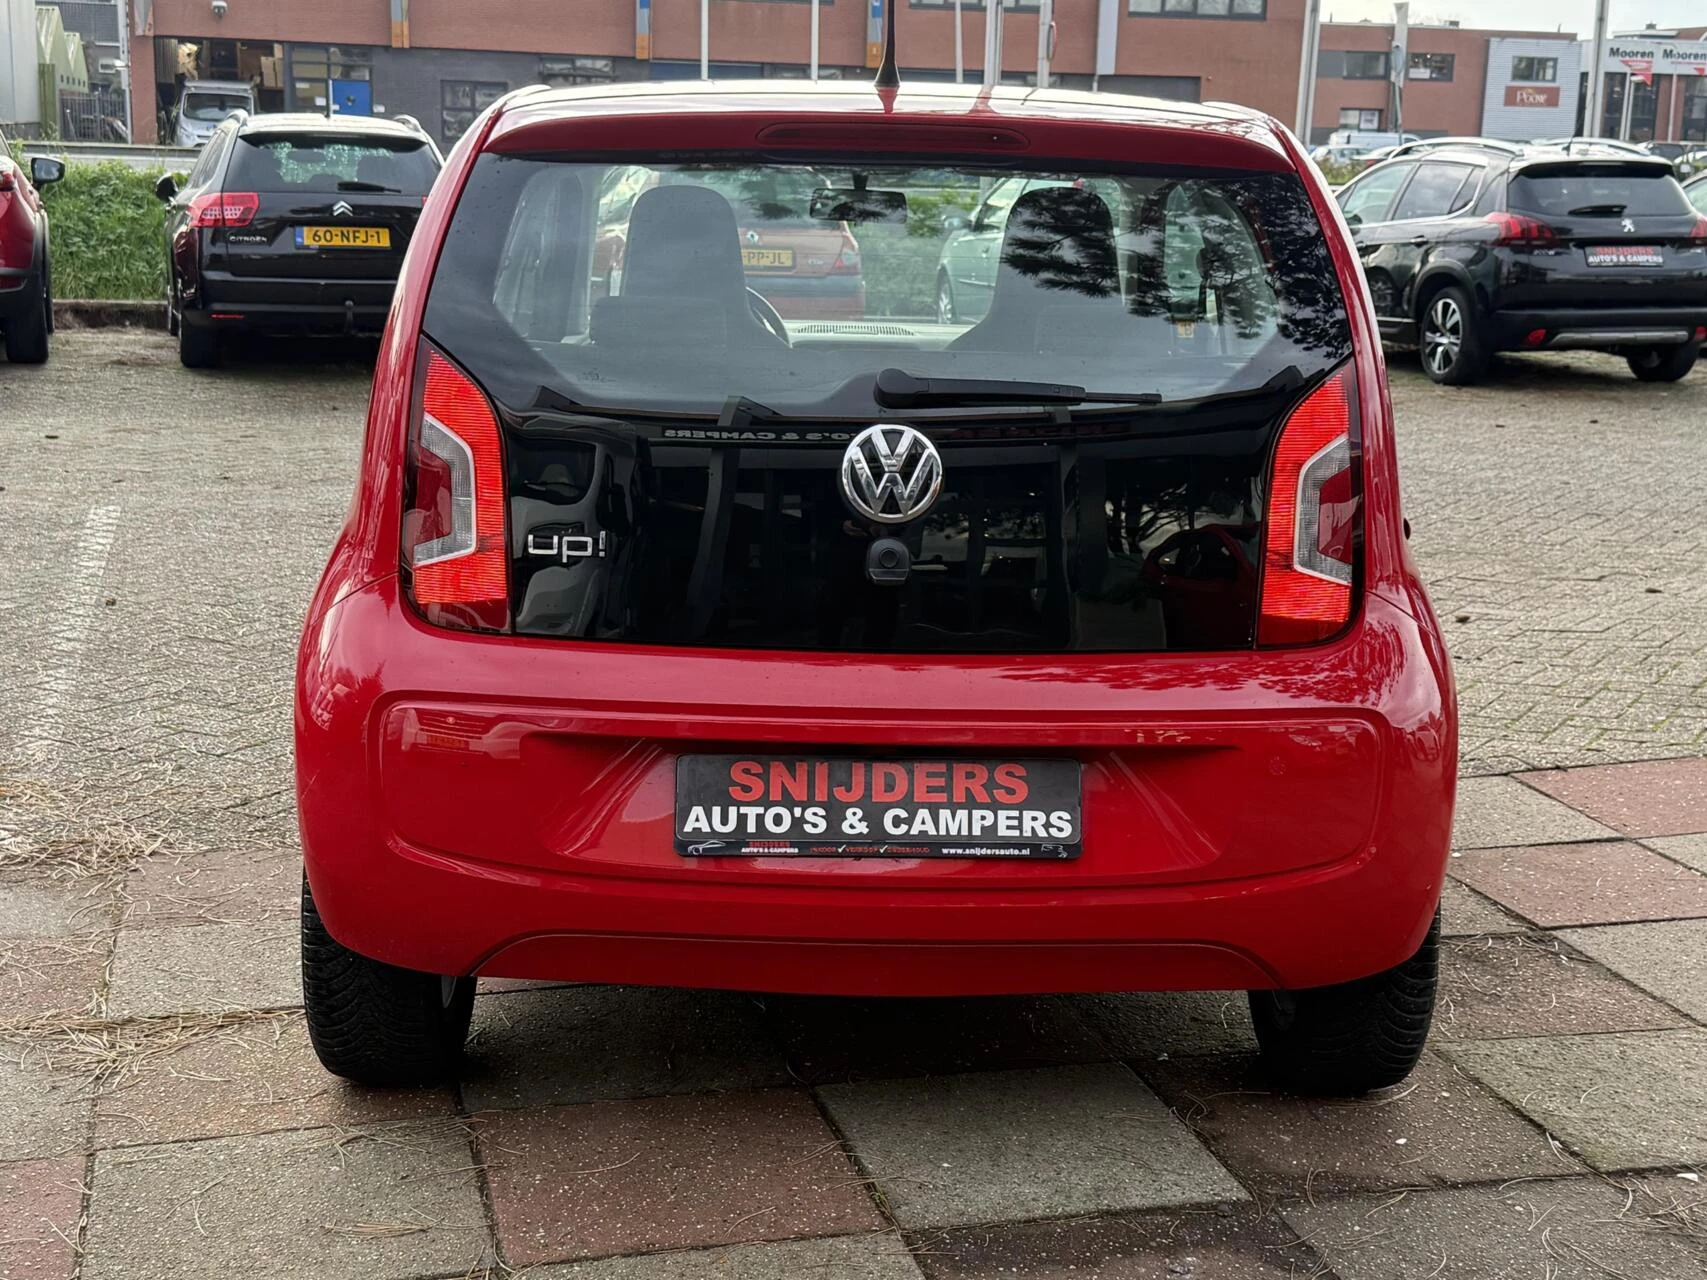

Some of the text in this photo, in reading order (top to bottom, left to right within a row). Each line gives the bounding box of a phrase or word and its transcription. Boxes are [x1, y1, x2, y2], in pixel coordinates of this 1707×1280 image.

[1608, 47, 1654, 59] Mooren
[1662, 48, 1706, 60] Mooren
[312, 229, 381, 243] 60-NFJ-1
[527, 530, 607, 563] up!
[729, 760, 1029, 805] SNIJDERS
[683, 805, 1073, 838] AUTO'S & CAMPERS
[941, 847, 1031, 856] www.snijdersauto.nl
